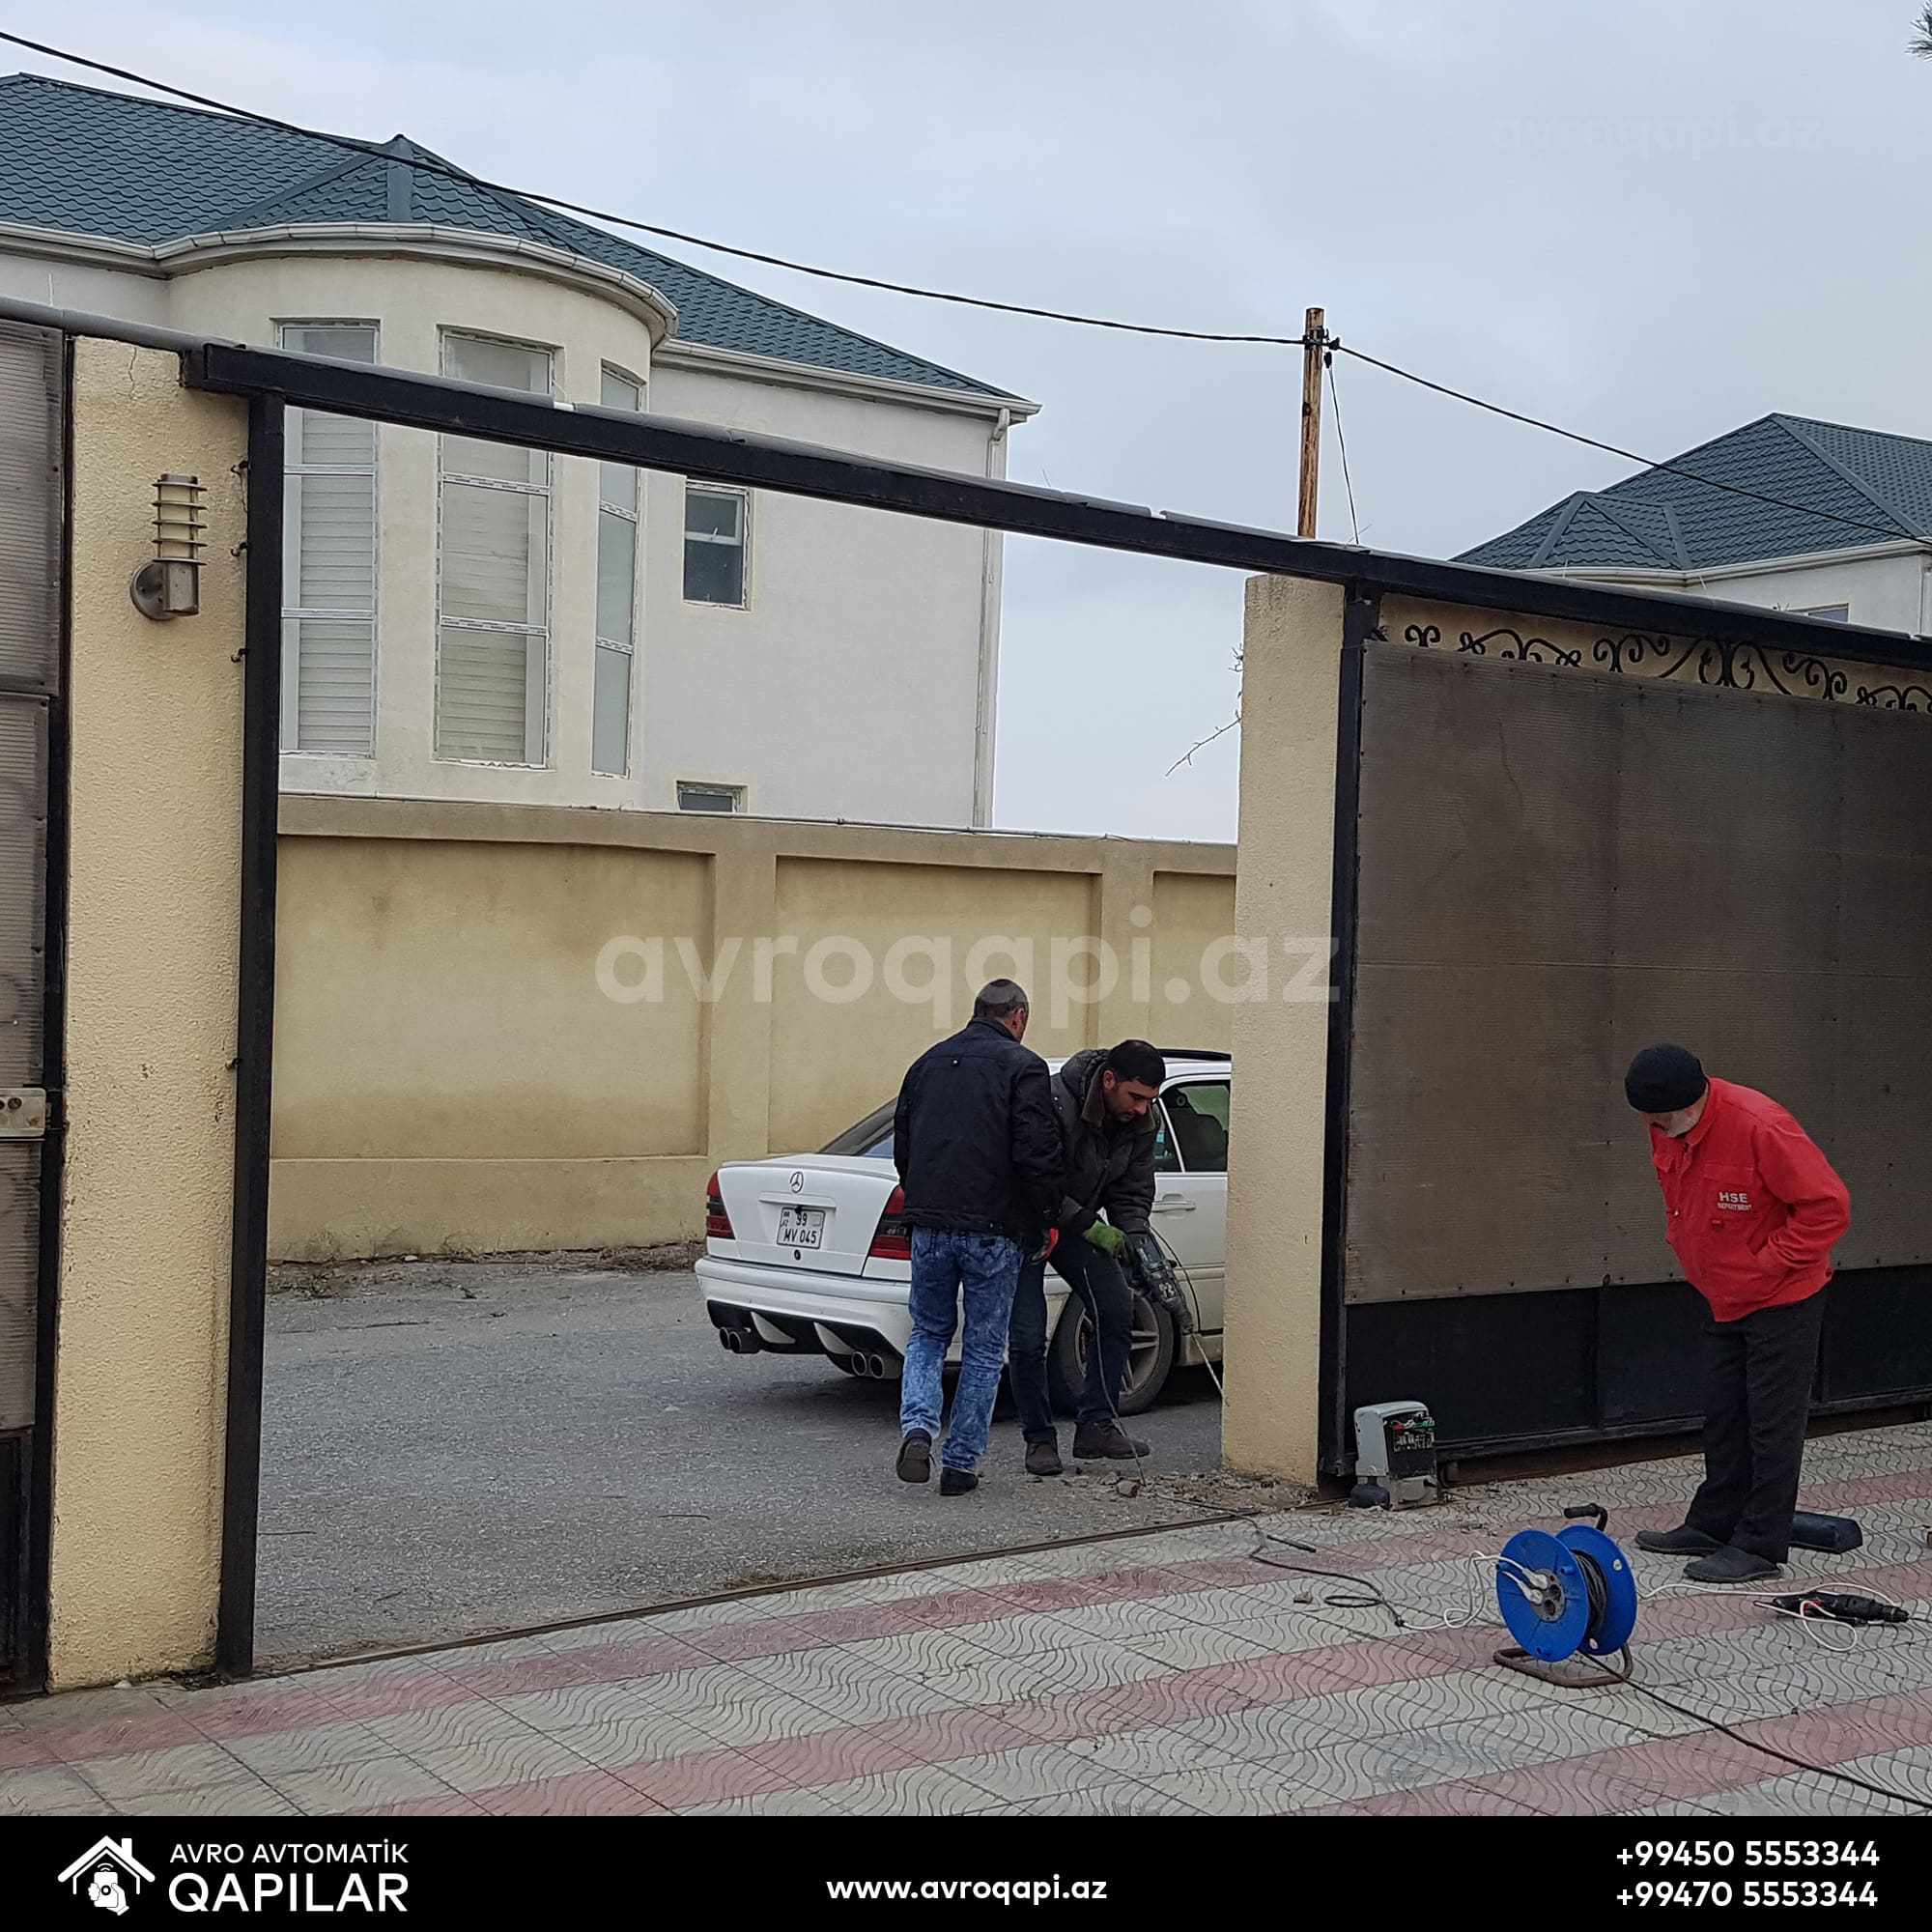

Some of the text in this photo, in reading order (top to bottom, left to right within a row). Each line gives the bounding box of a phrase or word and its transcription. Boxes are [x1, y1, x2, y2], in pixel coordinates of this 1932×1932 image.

[1719, 1191, 1747, 1204] HSE
[796, 1212, 808, 1226] 99
[799, 1230, 817, 1243] 045
